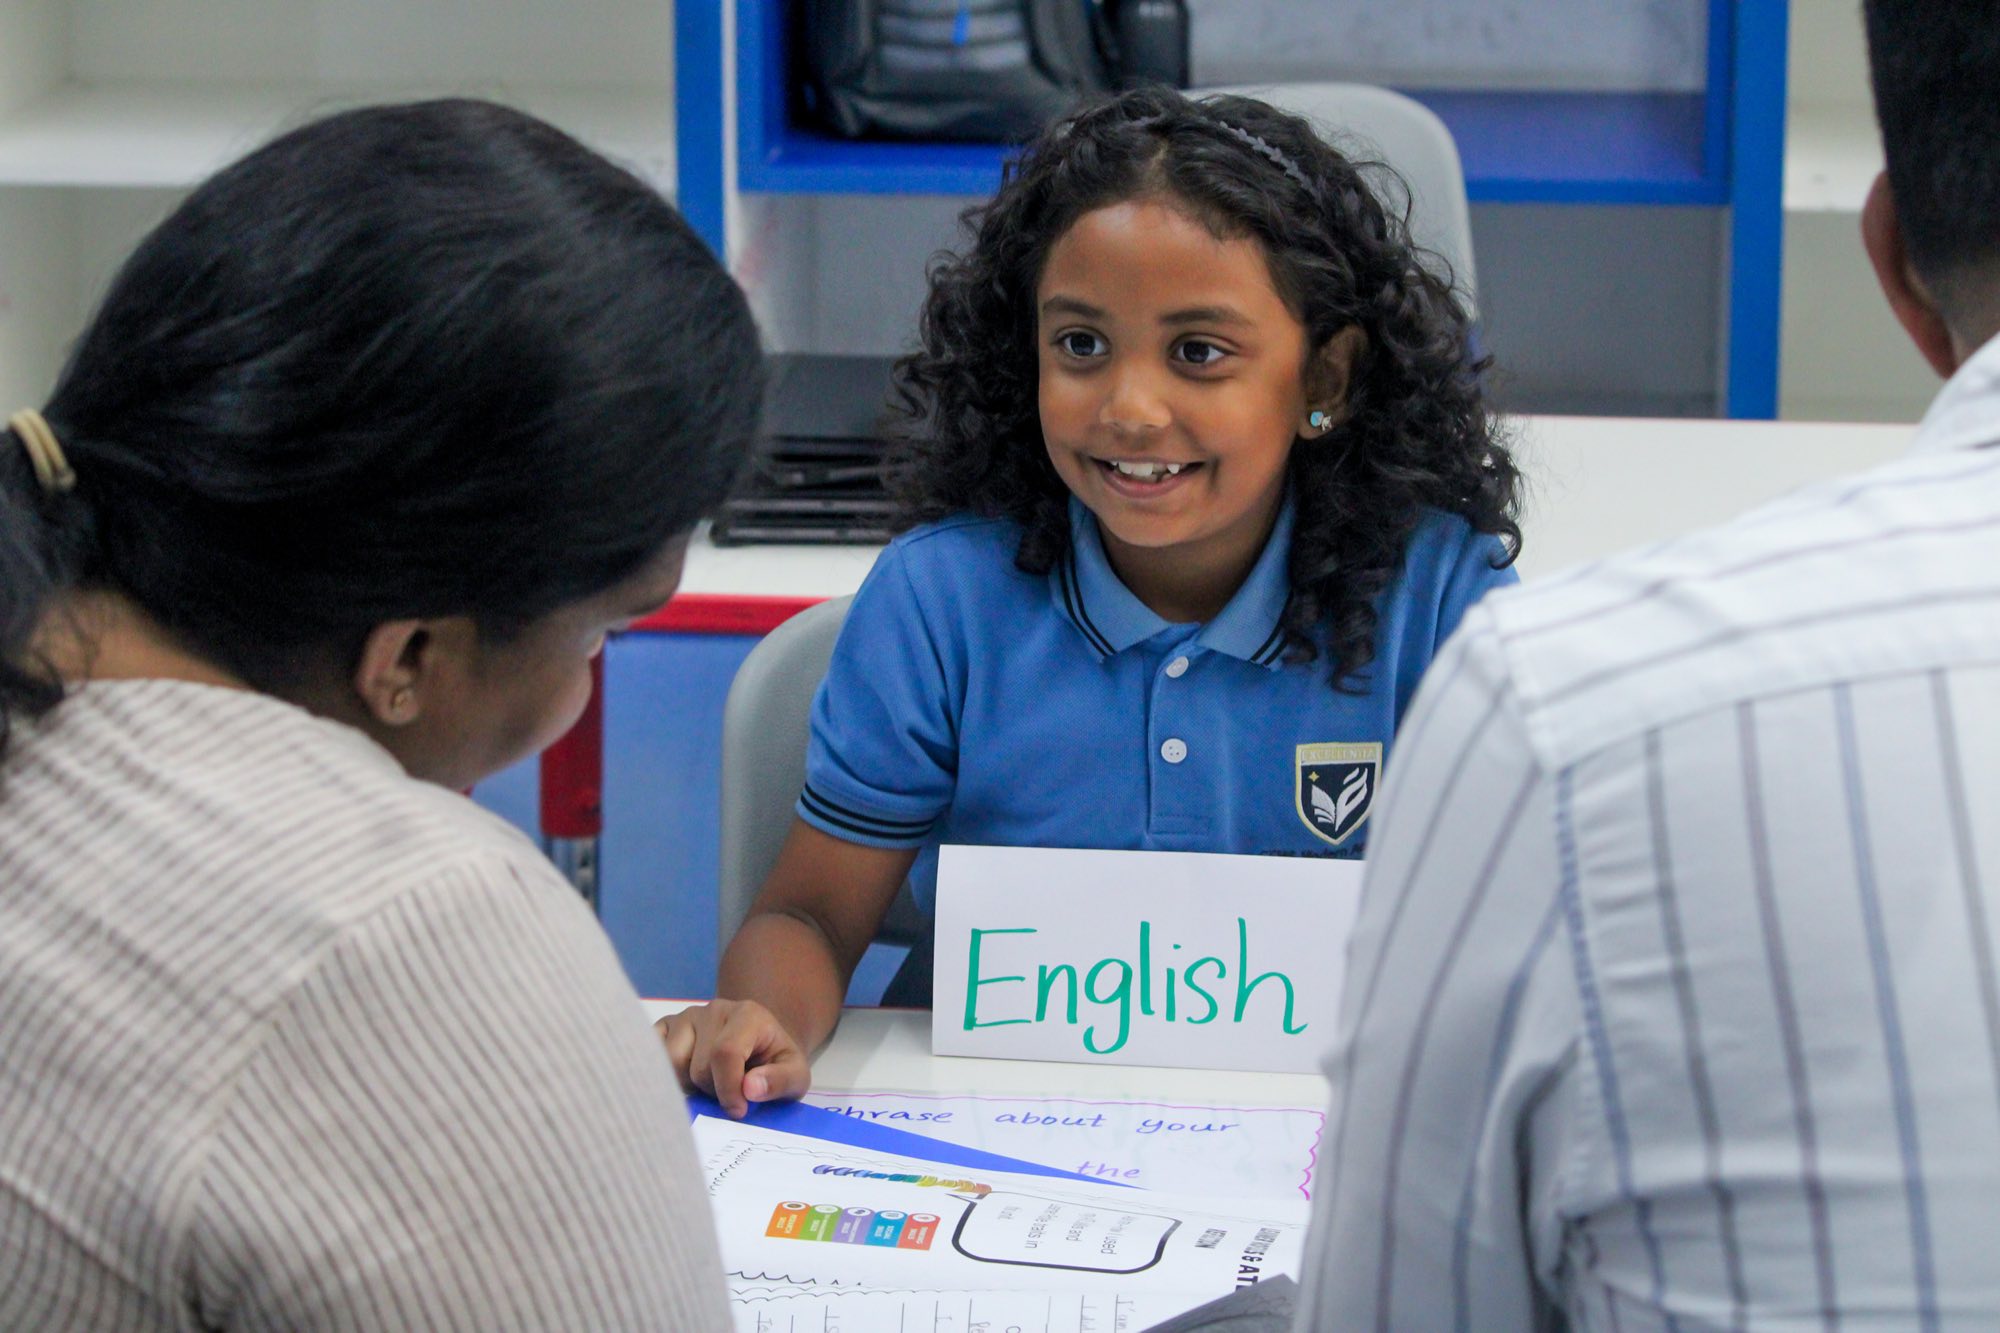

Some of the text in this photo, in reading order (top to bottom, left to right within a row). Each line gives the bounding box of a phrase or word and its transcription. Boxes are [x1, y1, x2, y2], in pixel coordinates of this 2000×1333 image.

[963, 917, 1309, 1054] English
[995, 1112, 1106, 1129] about
[1136, 1118, 1240, 1134] your
[1076, 1160, 1141, 1178] the
[1024, 1240, 1038, 1249] in
[1100, 1234, 1118, 1255] used
[1235, 1264, 1260, 1291] AT
